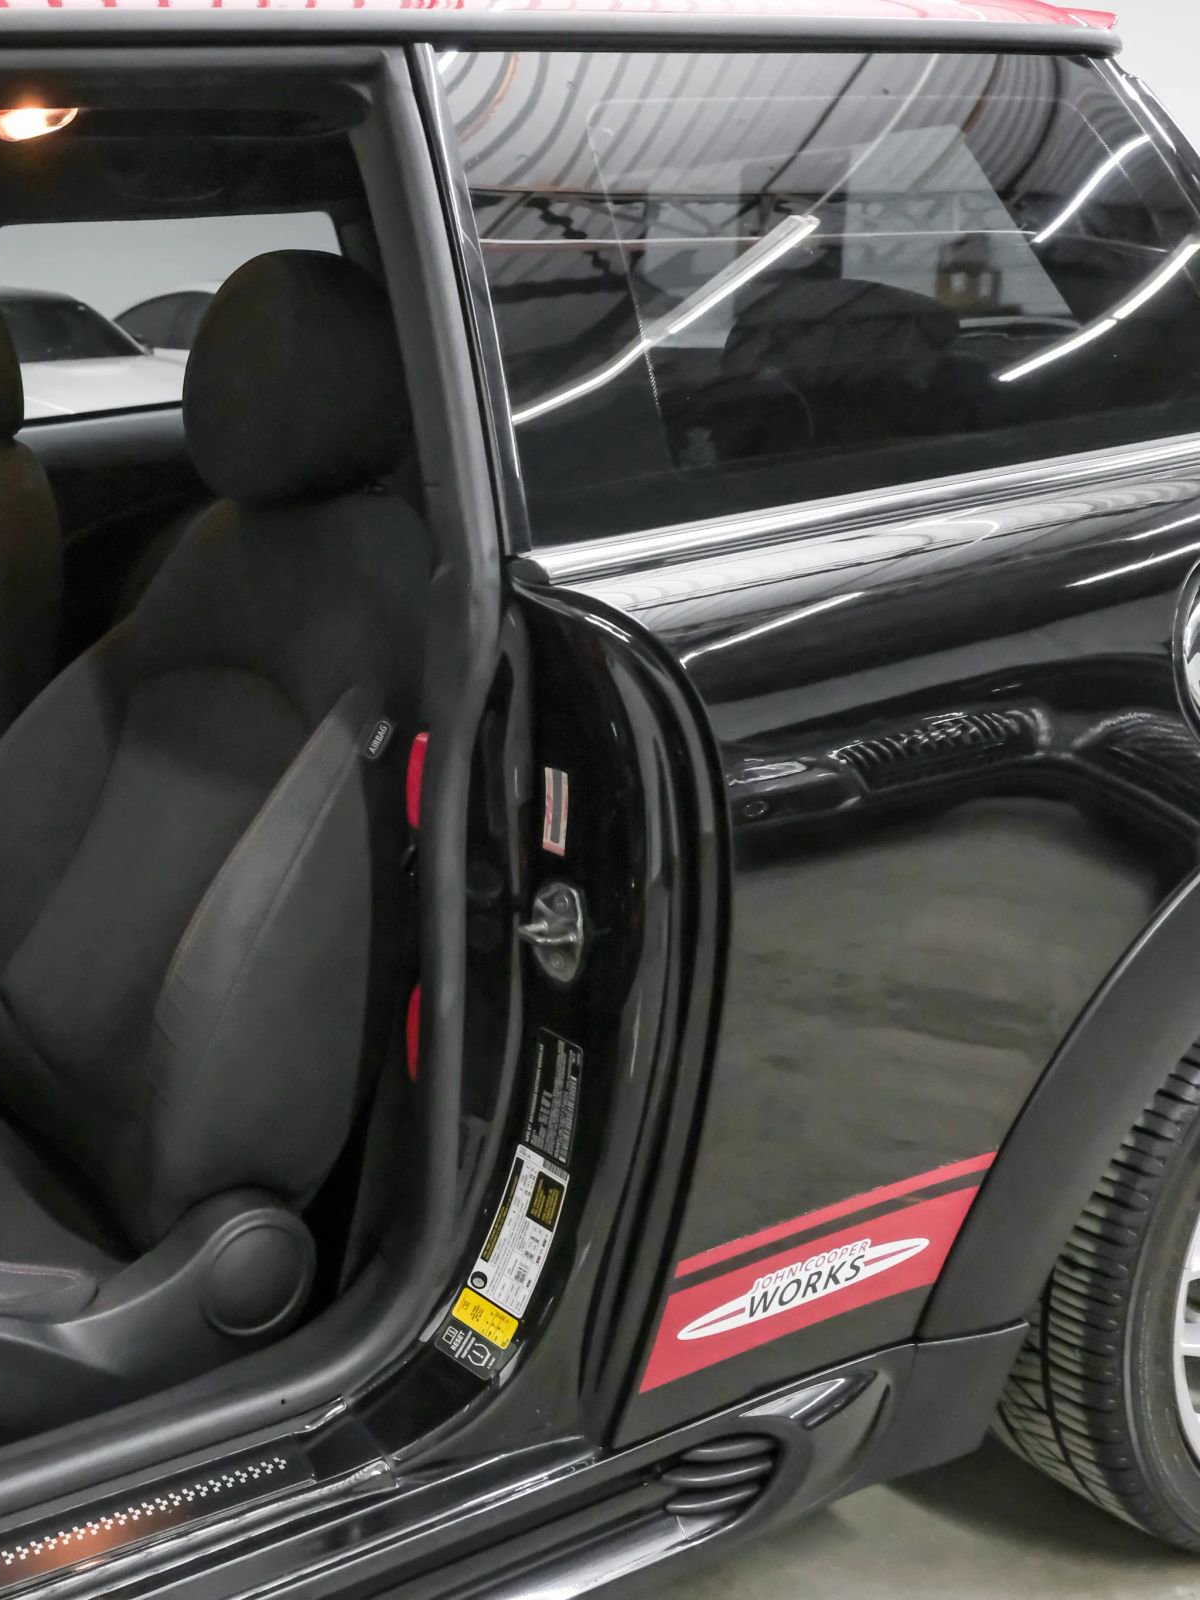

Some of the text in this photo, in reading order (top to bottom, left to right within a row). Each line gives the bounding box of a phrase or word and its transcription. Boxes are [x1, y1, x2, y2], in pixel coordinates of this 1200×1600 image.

[368, 724, 388, 754] AIRBAG
[748, 1254, 866, 1318] WORKS
[753, 1240, 869, 1294] JOHN COOPER
[450, 1329, 466, 1352] RESET
